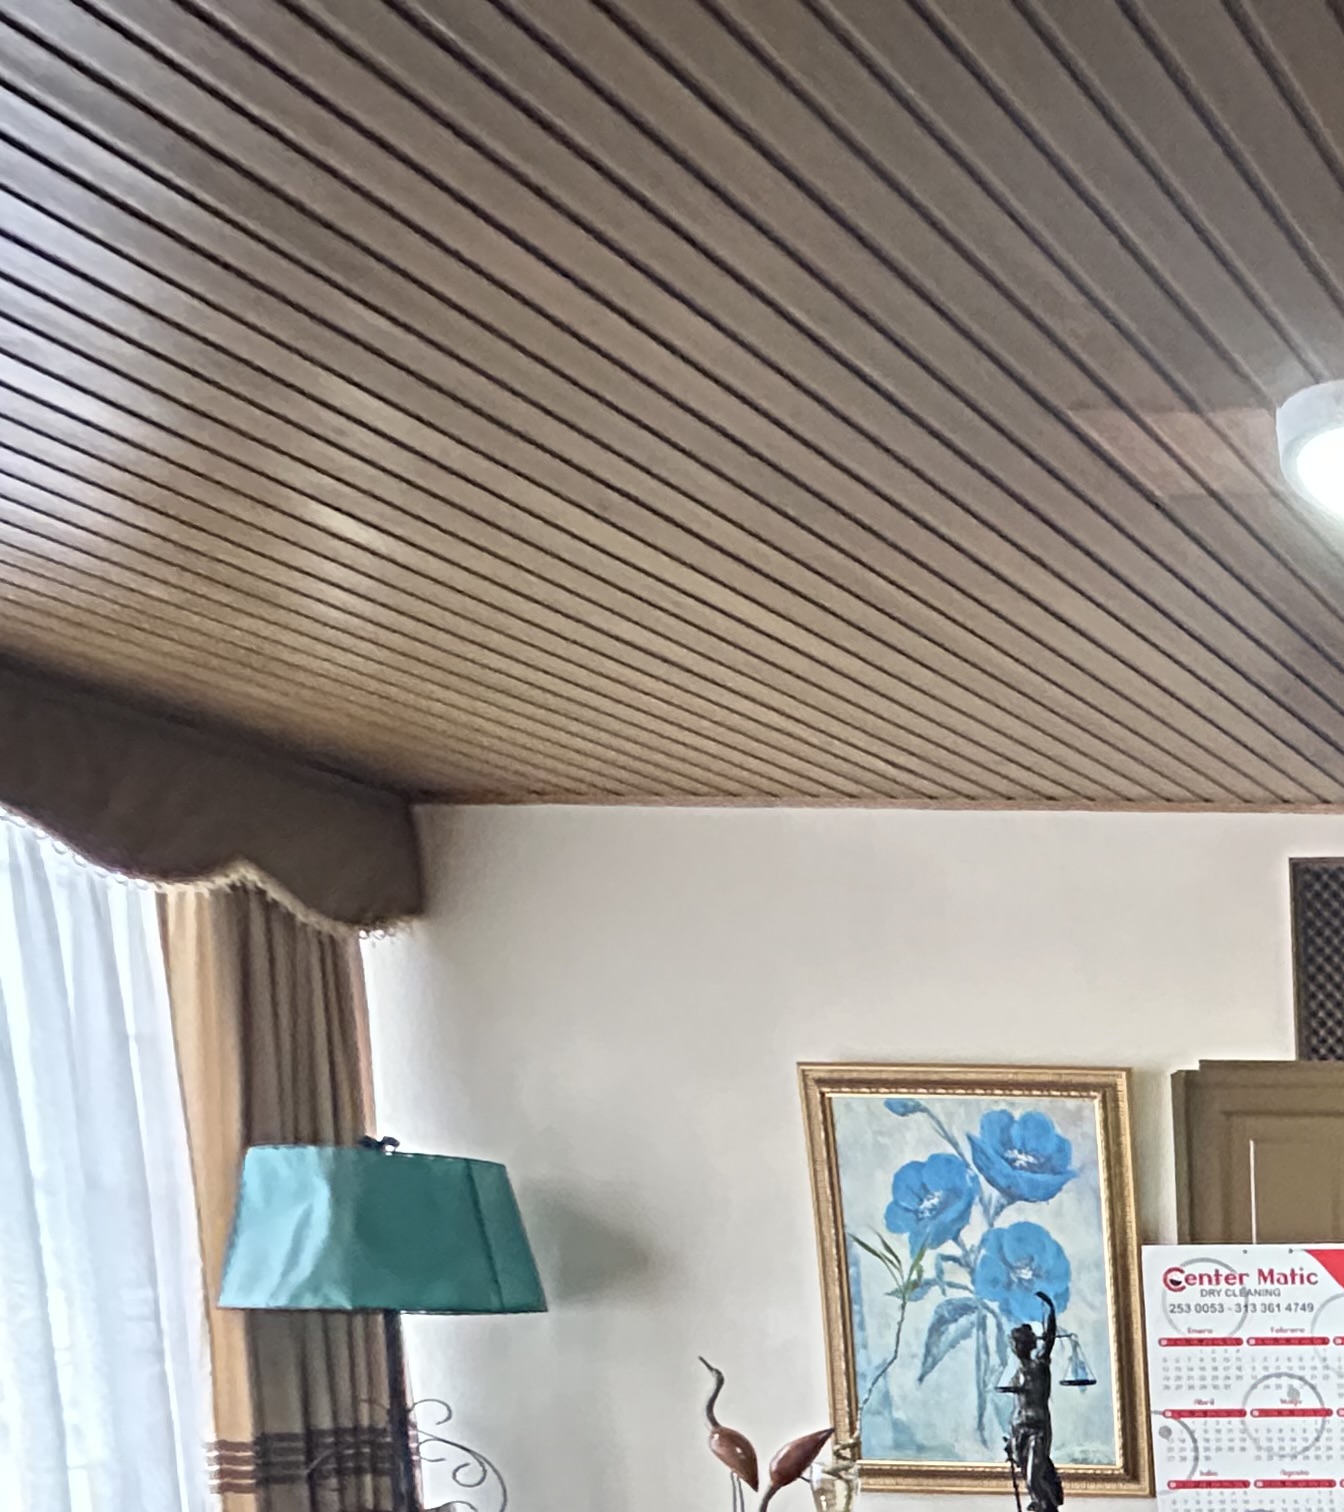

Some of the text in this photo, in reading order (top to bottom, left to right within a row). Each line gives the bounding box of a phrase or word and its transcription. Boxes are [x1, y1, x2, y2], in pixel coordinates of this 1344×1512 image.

[1163, 1266, 1319, 1292] Center Matic
[1200, 1288, 1281, 1298] DRY CLEANING
[1169, 1303, 1191, 1314] 253
[1195, 1303, 1225, 1314] 0053
[1235, 1303, 1257, 1314] 313
[1260, 1303, 1281, 1313] 361
[1285, 1302, 1314, 1313] 4749
